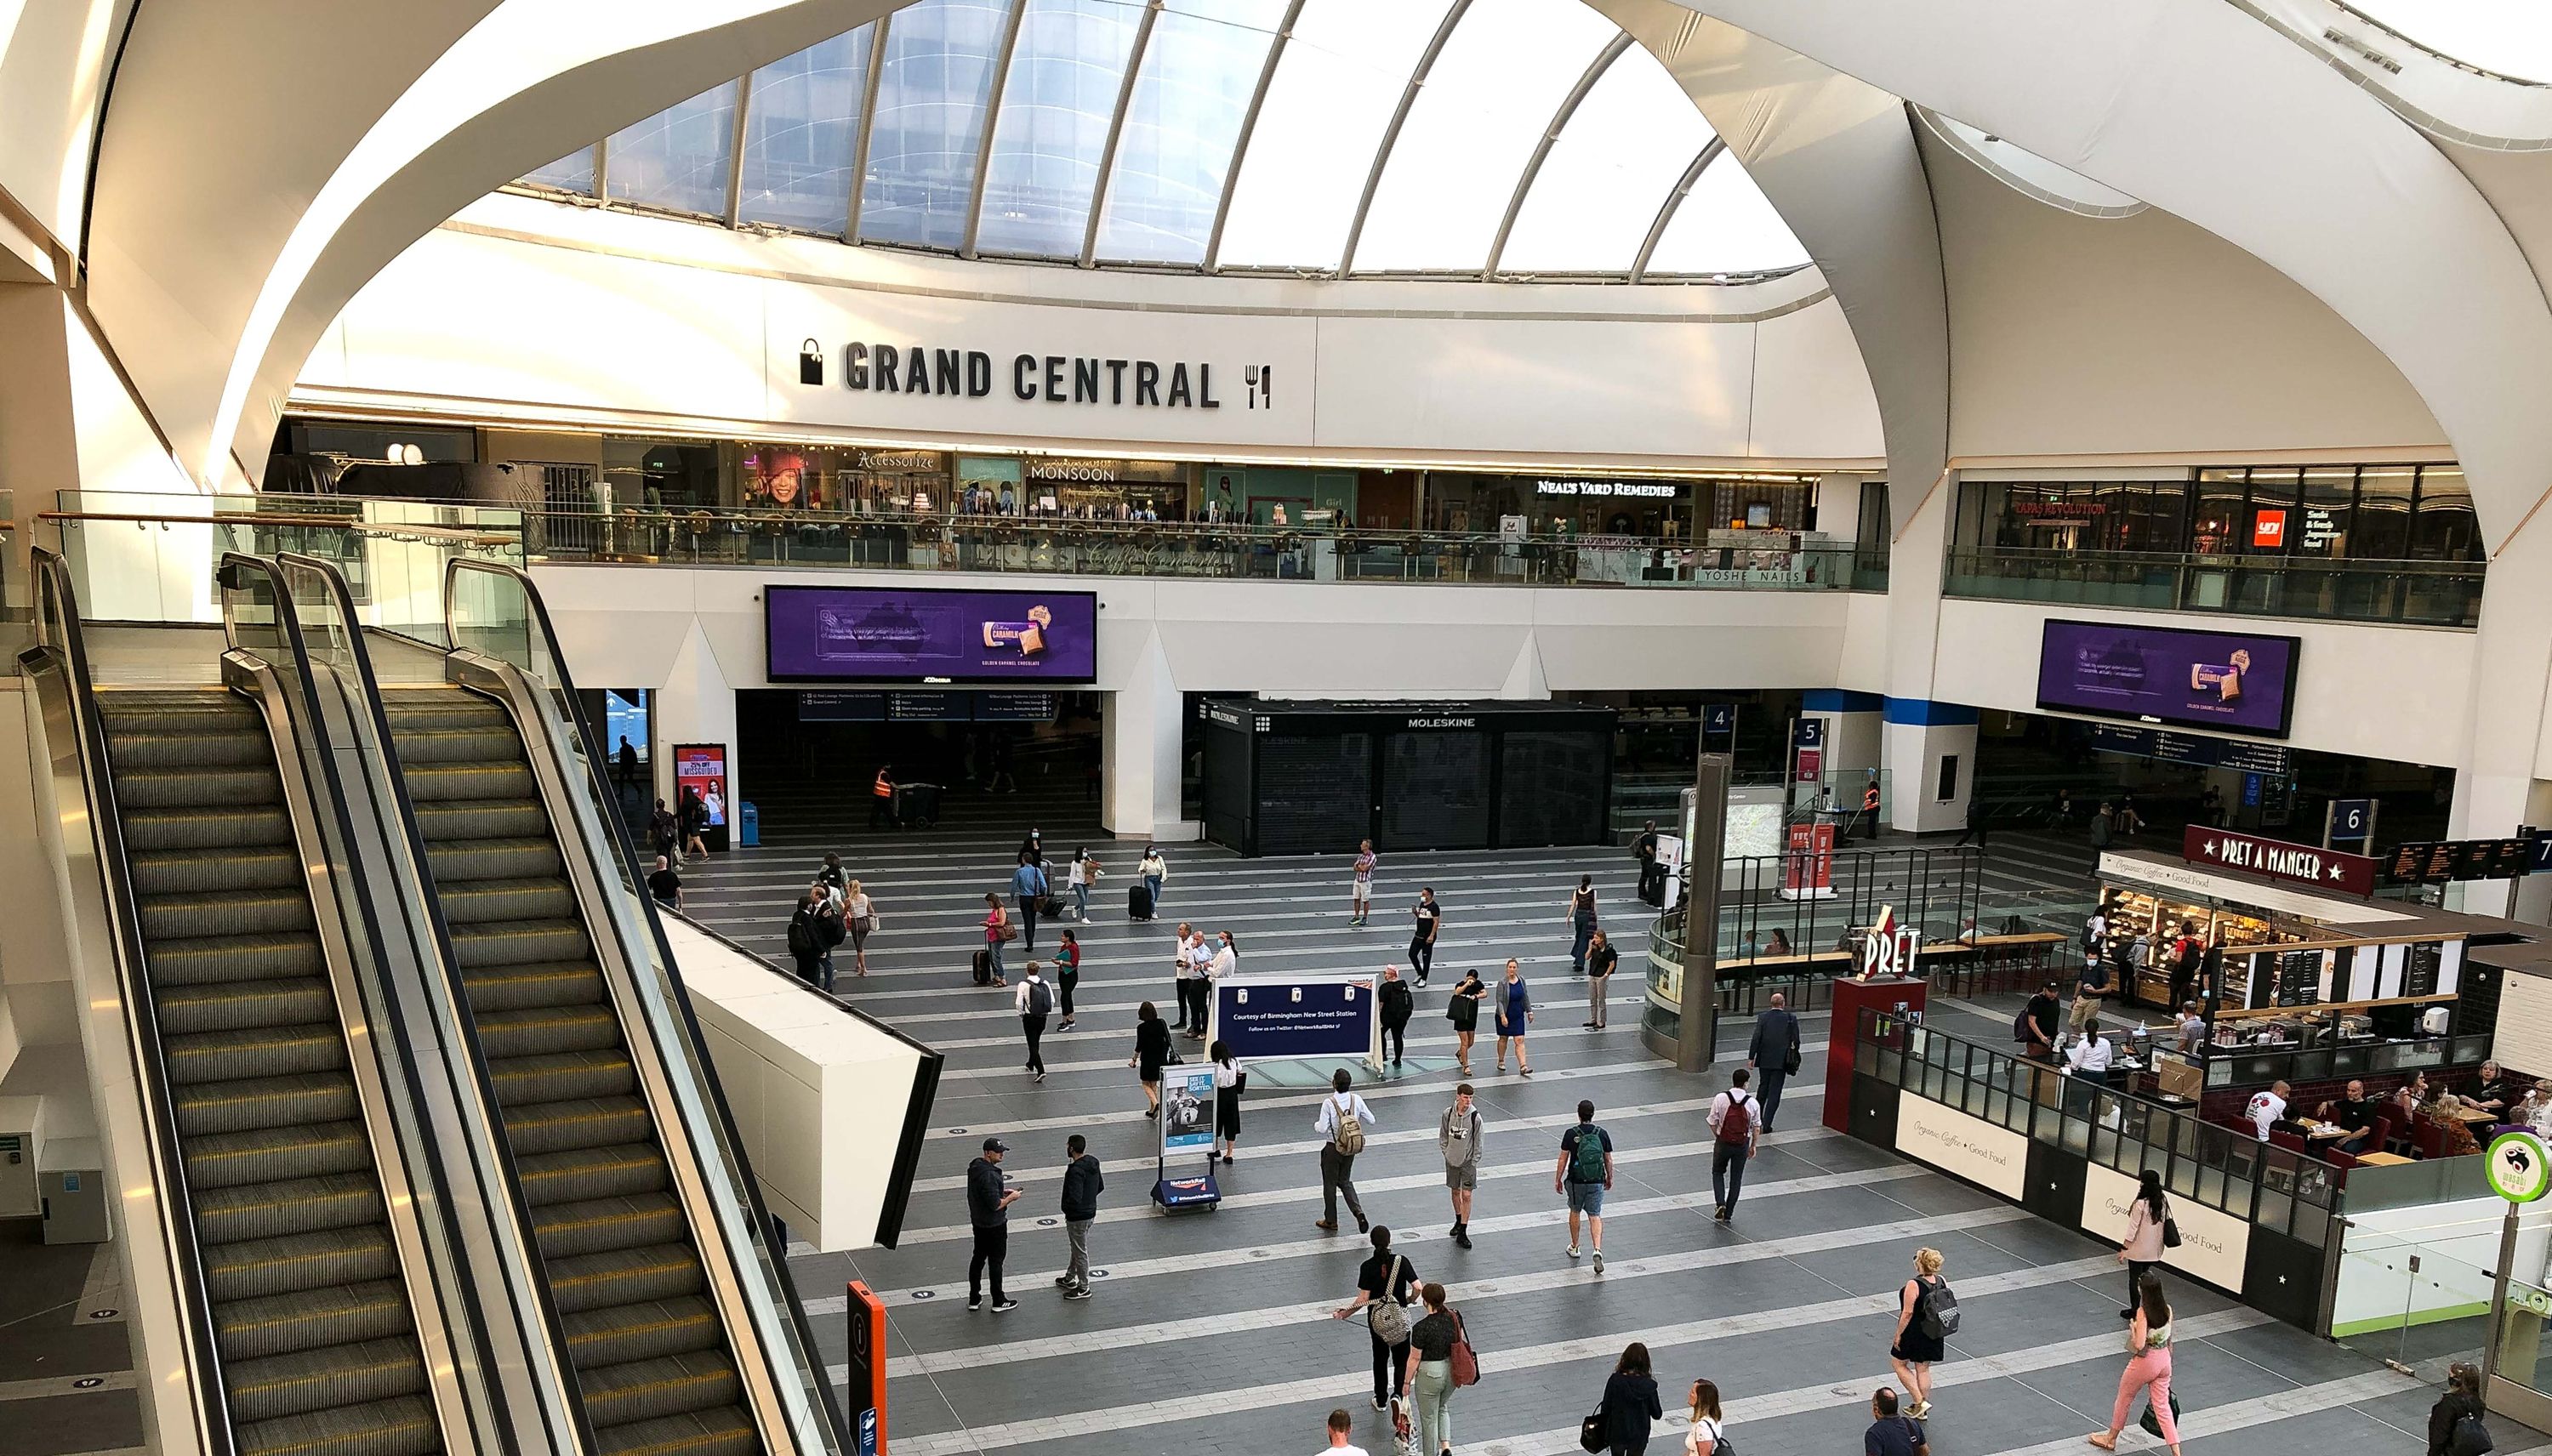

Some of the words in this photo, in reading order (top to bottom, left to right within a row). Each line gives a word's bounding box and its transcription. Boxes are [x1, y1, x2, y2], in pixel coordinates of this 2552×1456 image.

[845, 340, 992, 399] GRAND
[1013, 354, 1221, 408] CENTRAL
[1031, 465, 1114, 482] MONSOON
[1579, 481, 1612, 496] YARD
[1614, 483, 1676, 498] REMEDIES
[2045, 502, 2106, 515] REVOLUTION
[2305, 520, 2313, 529] &
[1761, 572, 1800, 582] NAILS
[992, 630, 1019, 639] CARAMILK
[1408, 718, 1476, 728] MOLESKINE
[1714, 710, 1725, 725] 4
[1805, 724, 1815, 740] 5
[684, 767, 717, 776] MISSGUIDED
[2348, 809, 2361, 829] 6
[2540, 839, 2552, 862] 7
[2221, 838, 2253, 867] PRET
[2254, 845, 2264, 869] A
[2267, 846, 2321, 881] MANGER
[2116, 859, 2142, 873] Organic
[2144, 865, 2163, 879] Coffee
[2172, 872, 2190, 884] Good
[2191, 876, 2210, 888] Food
[1864, 930, 1921, 975] PRET
[1913, 1120, 1940, 1139] Organic
[1940, 1131, 1962, 1147] Coffee
[1968, 1142, 1988, 1158] Good
[1989, 1150, 2007, 1166] Food
[1170, 1177, 1205, 1186] NetworkRail
[2503, 1172, 2526, 1186] wasabi
[2175, 1226, 2198, 1244] Good
[2201, 1236, 2223, 1254] Food
